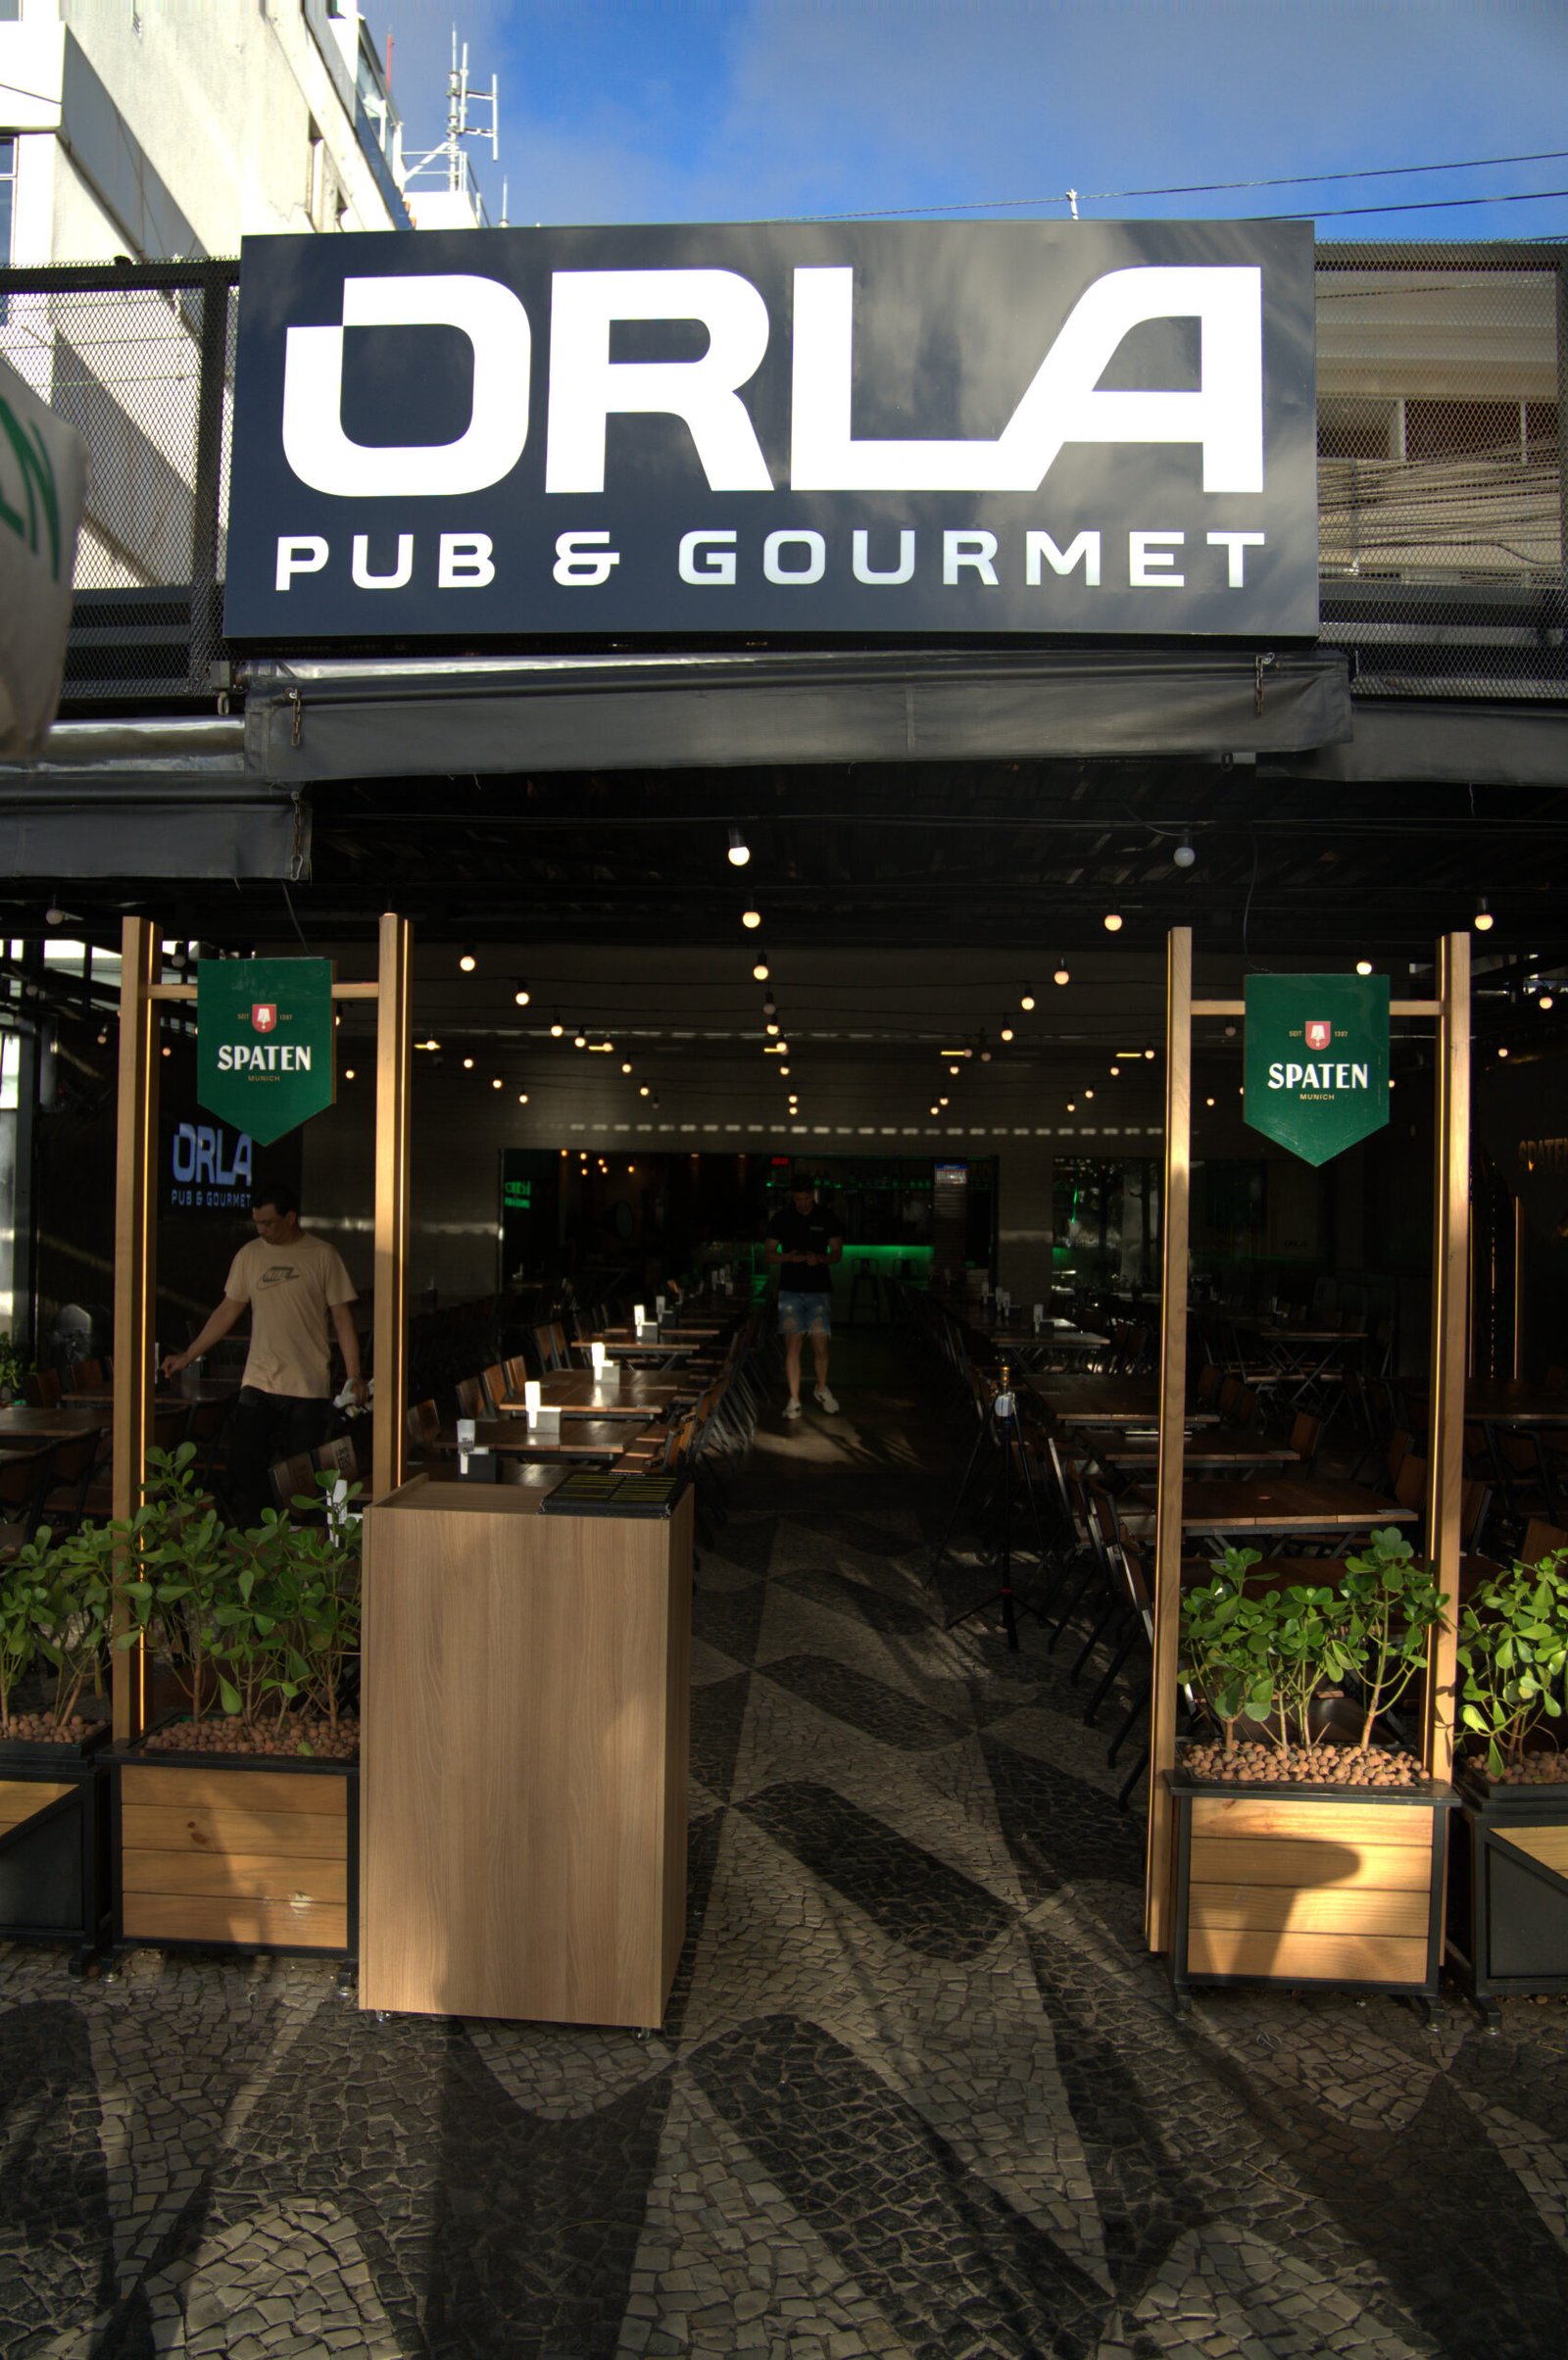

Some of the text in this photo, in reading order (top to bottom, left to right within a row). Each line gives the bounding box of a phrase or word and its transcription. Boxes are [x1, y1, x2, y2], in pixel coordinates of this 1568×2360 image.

[282, 267, 1263, 497] ORLA
[275, 528, 1268, 591] PUB & GOURMET
[1288, 1029, 1302, 1038] SEIT
[217, 1044, 312, 1071] SPATEN
[247, 1074, 281, 1083] MUNICH
[1267, 1062, 1368, 1090] SPATEN
[172, 1122, 253, 1188] ORLA
[171, 1189, 192, 1207] PUB
[206, 1191, 252, 1208] GOURMET
